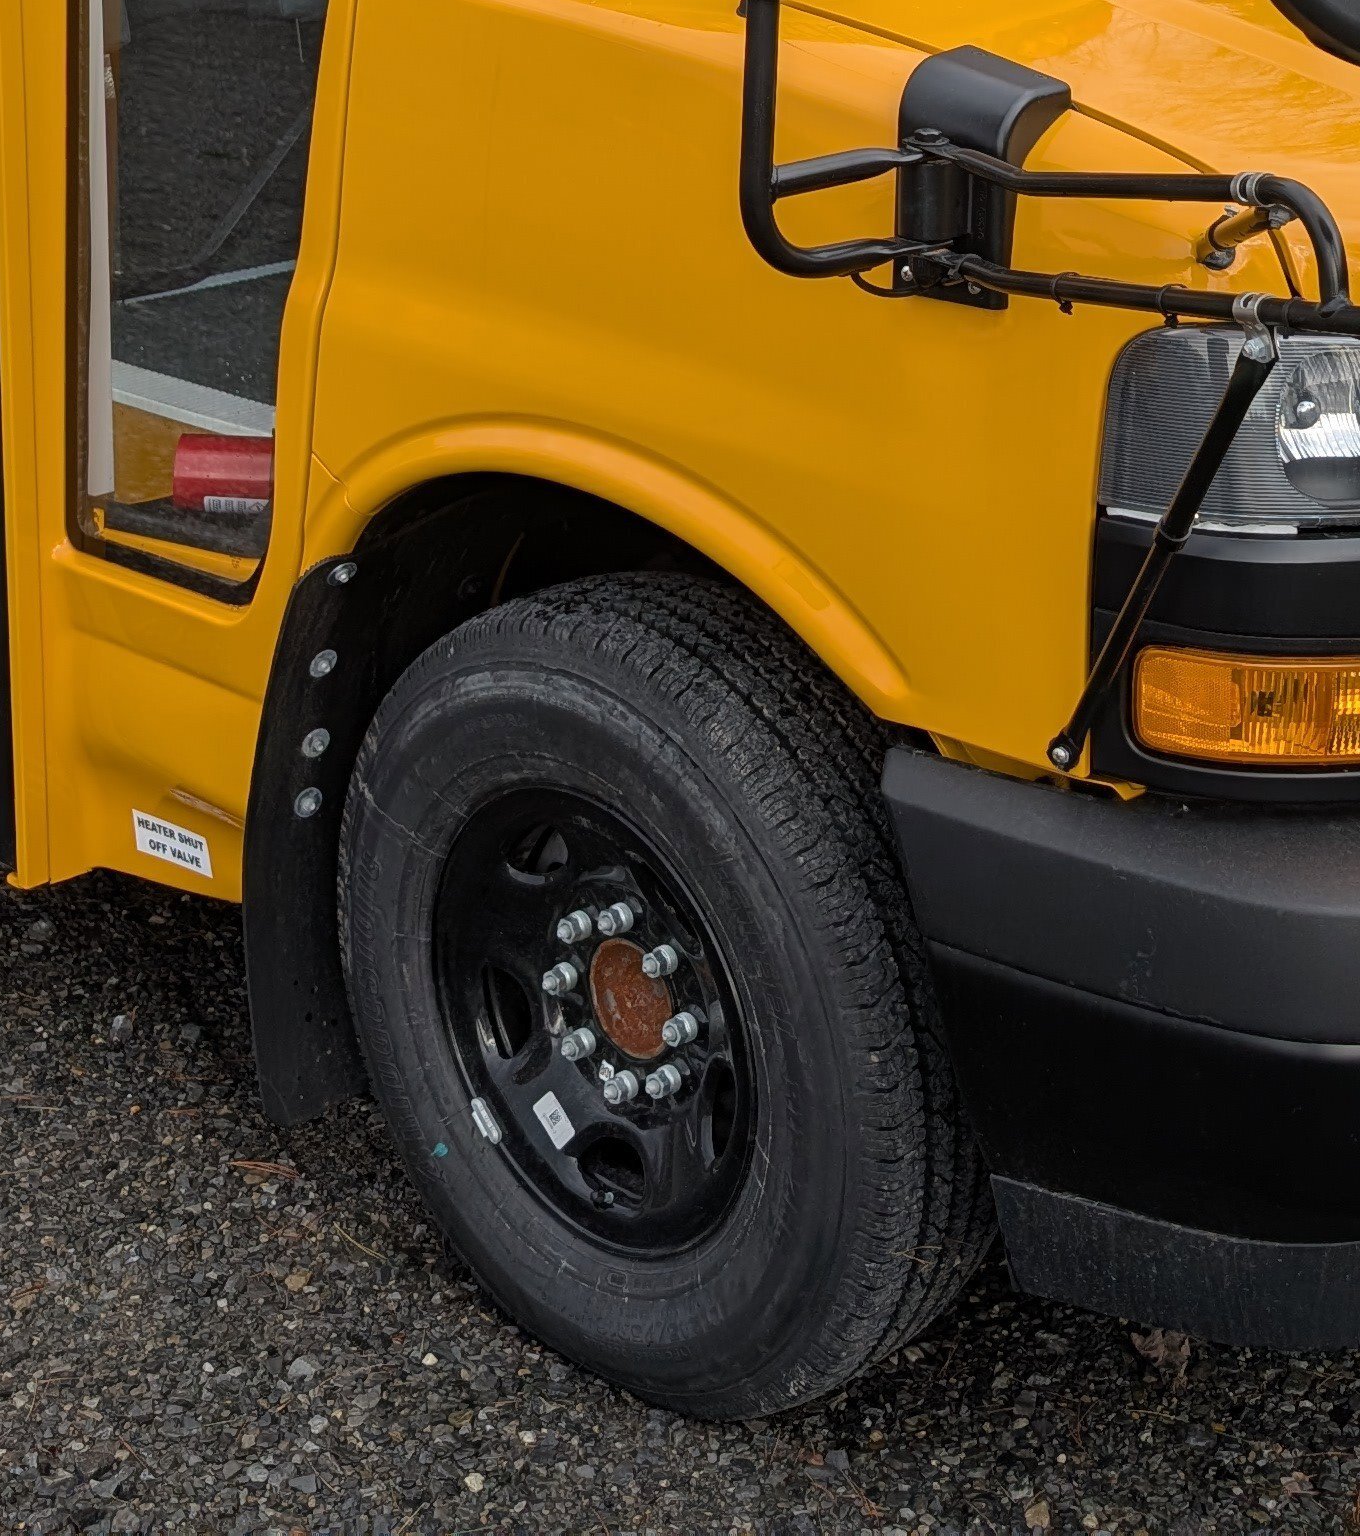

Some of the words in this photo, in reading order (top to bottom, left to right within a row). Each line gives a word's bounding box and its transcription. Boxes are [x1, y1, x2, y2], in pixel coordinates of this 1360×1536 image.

[136, 816, 177, 841] HEATER
[177, 832, 204, 852] SHUT
[148, 838, 168, 855] OFF
[168, 845, 202, 869] VALVE
